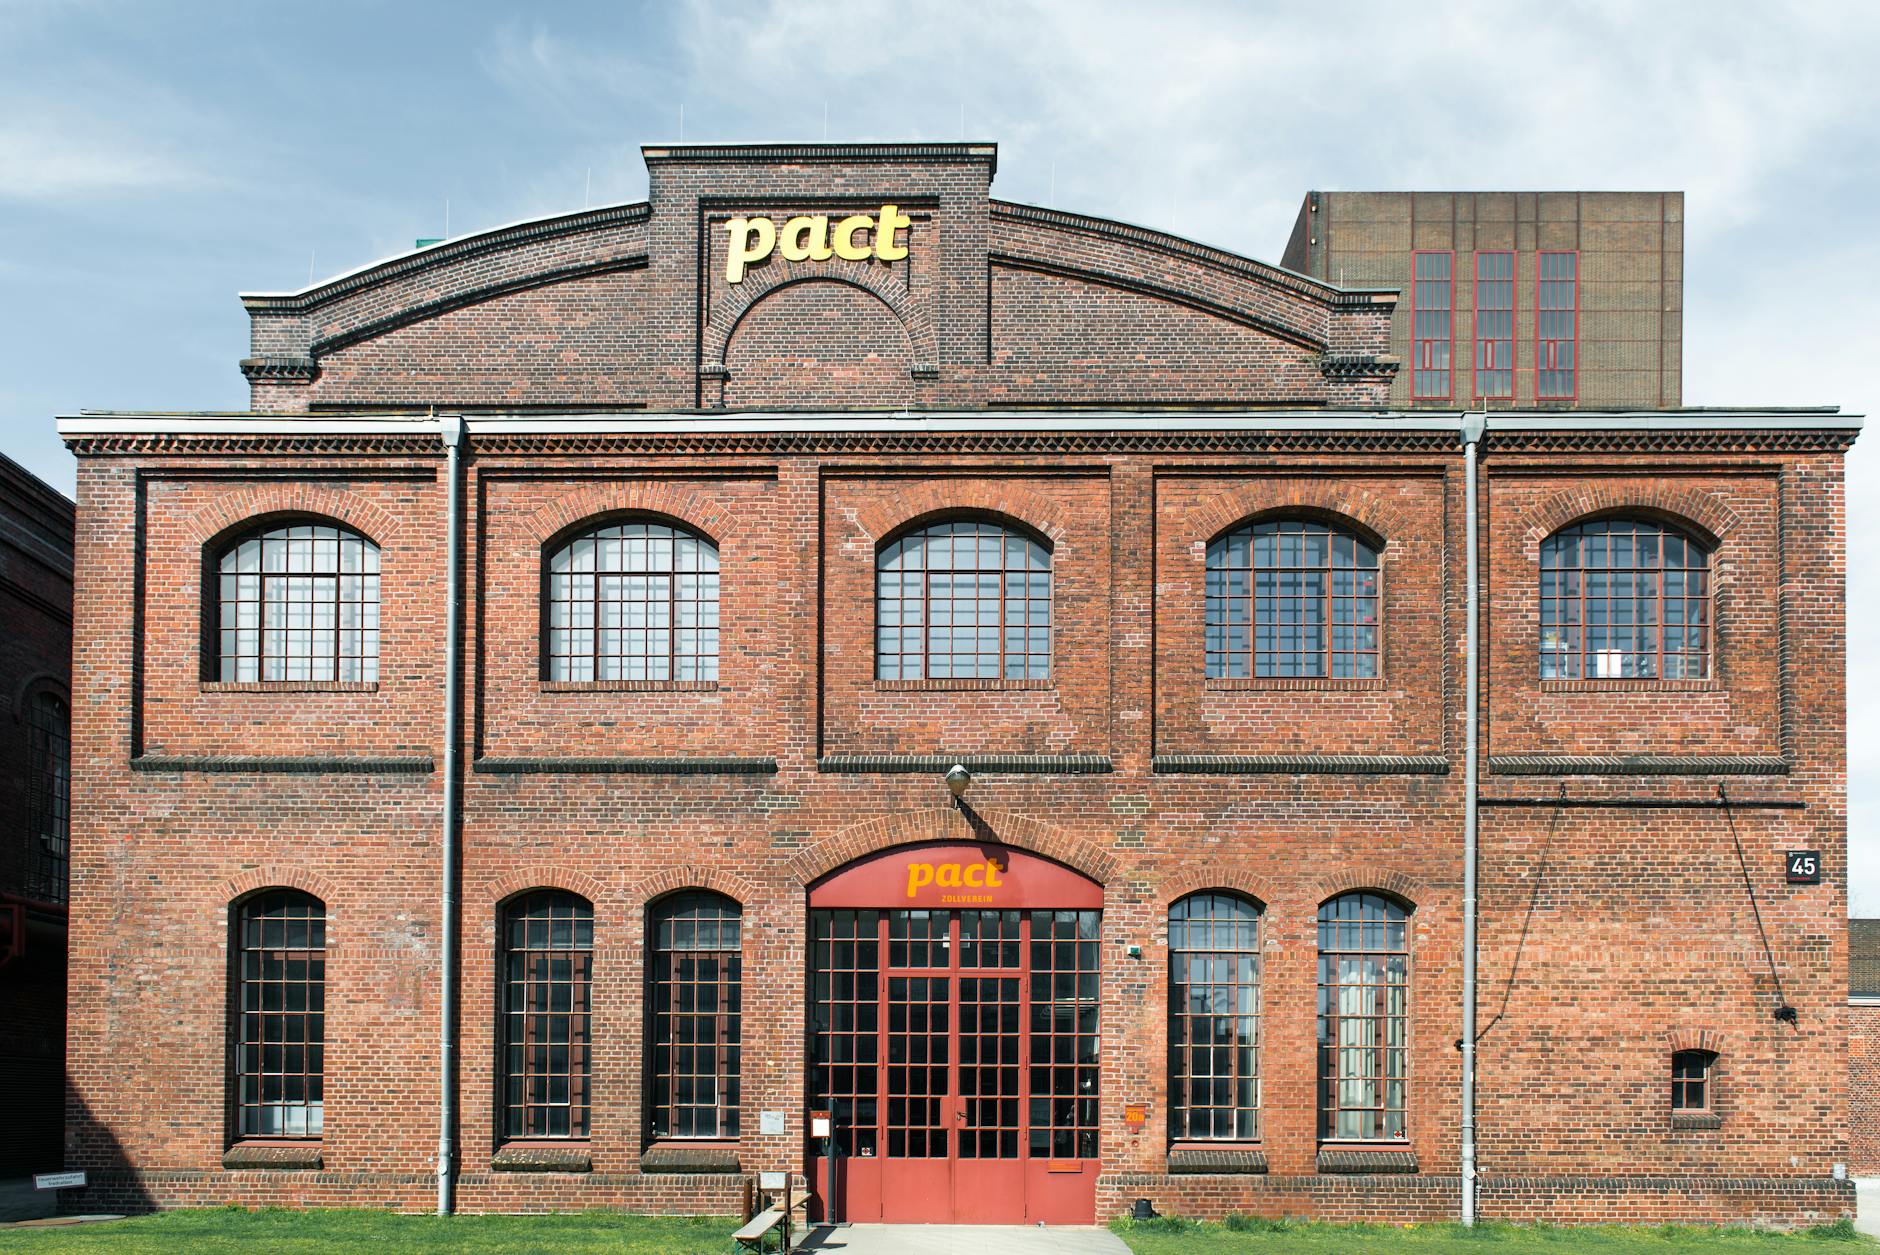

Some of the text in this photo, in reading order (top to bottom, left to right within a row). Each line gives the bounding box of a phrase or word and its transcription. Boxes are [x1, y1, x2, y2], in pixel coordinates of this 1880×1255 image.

[725, 204, 911, 284] pact
[907, 857, 1004, 898] pact
[1791, 857, 1816, 875] 45
[941, 895, 993, 903] ZOLLVEREIN
